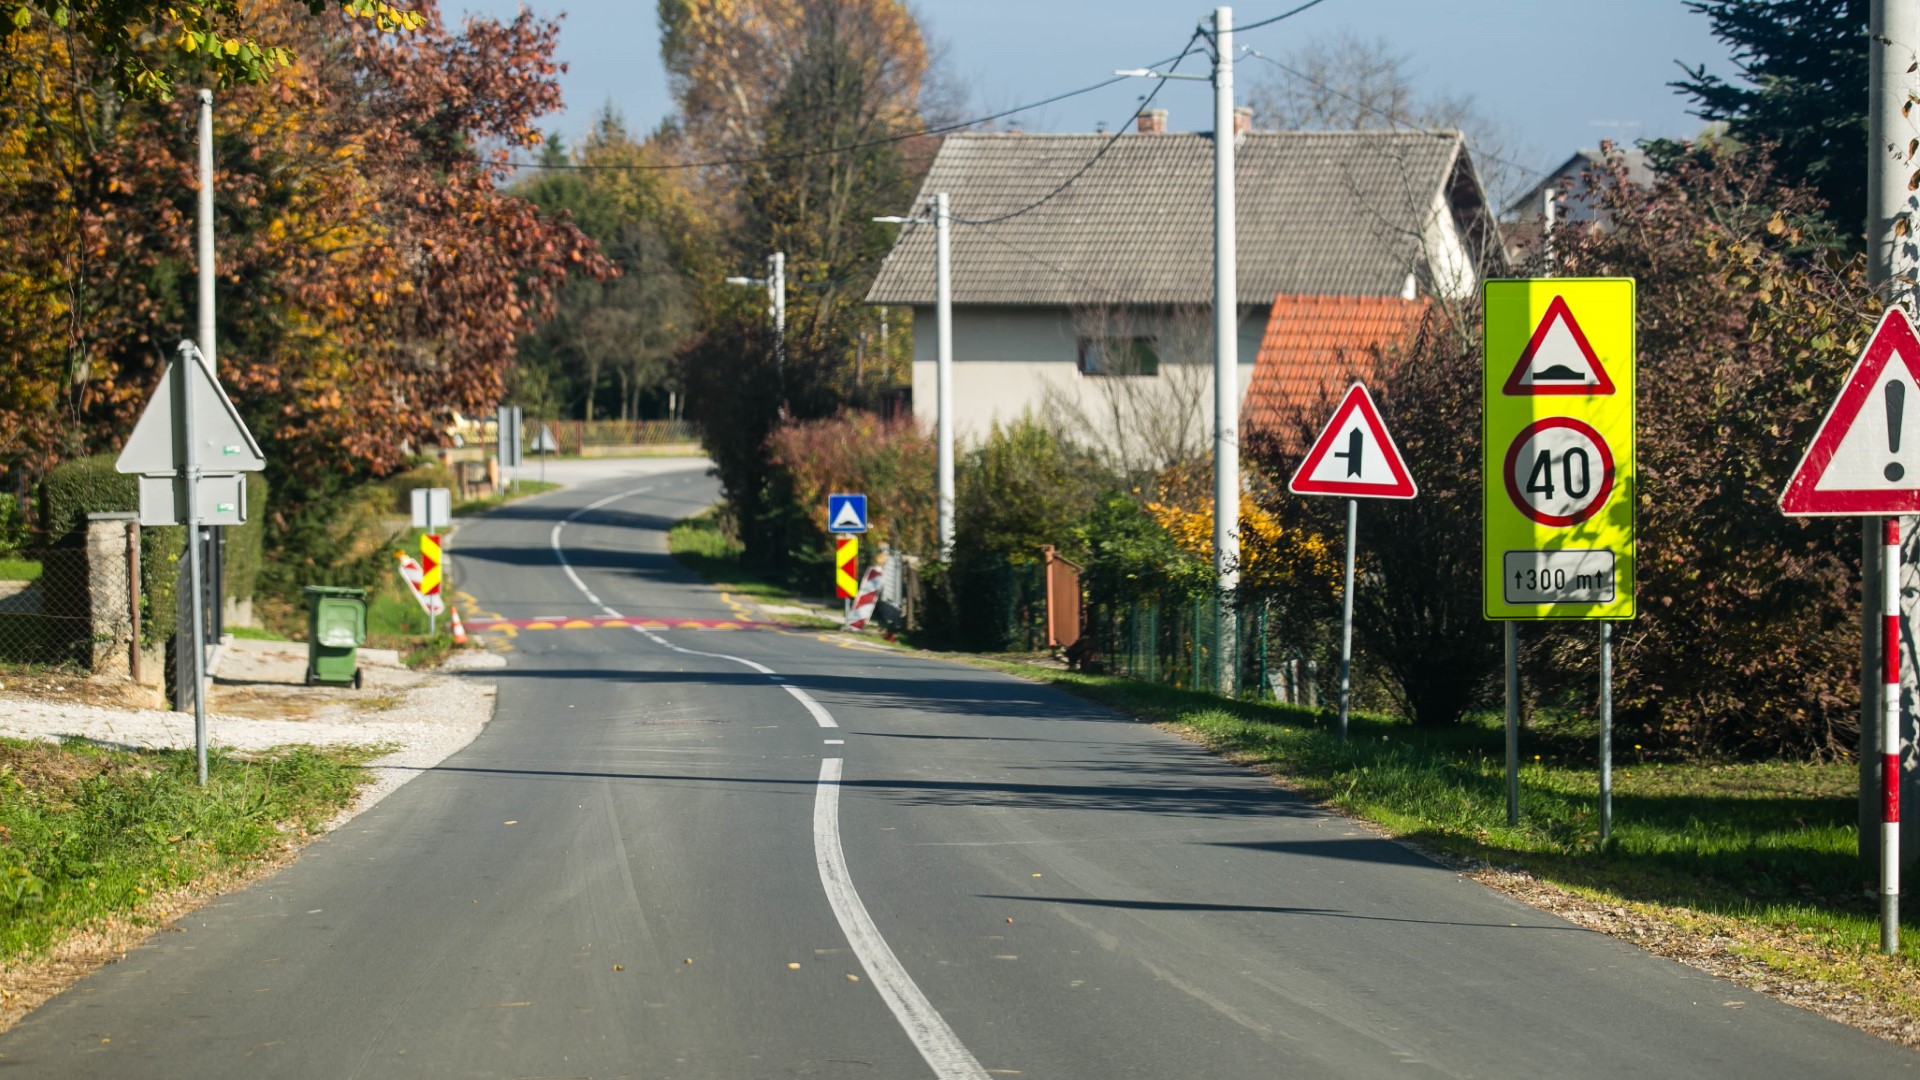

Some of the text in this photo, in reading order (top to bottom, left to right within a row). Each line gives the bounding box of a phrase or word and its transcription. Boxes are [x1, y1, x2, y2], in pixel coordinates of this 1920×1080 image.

[1526, 447, 1590, 500] 40
[1526, 569, 1592, 590] 300 m
